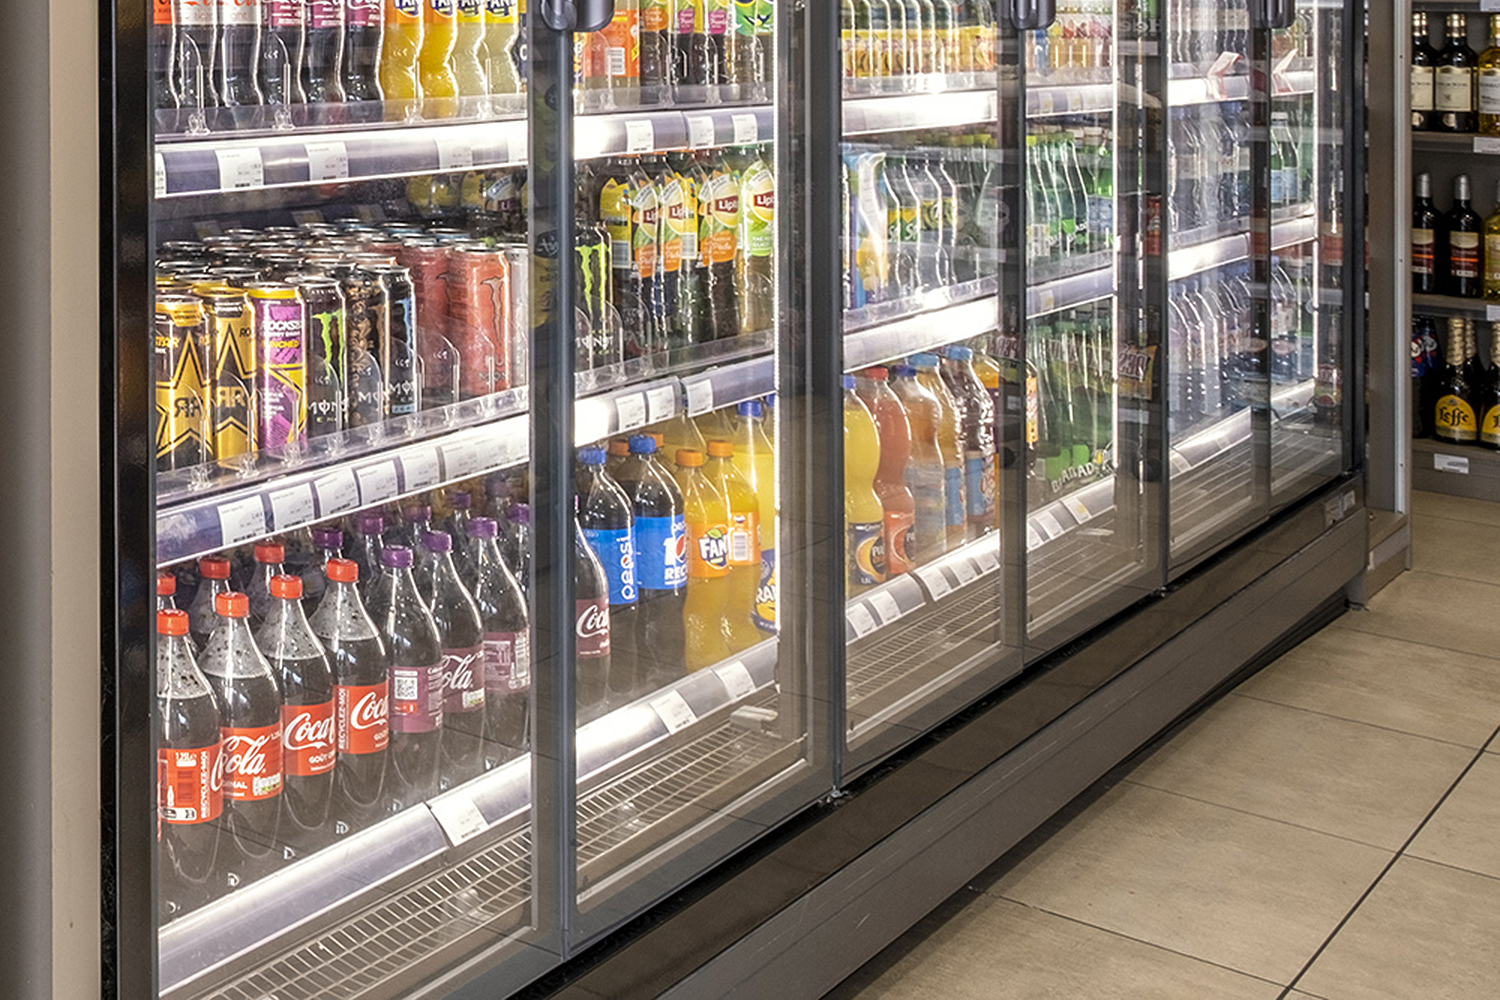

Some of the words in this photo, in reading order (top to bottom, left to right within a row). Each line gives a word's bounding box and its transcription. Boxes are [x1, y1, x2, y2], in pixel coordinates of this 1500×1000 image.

[1438, 406, 1470, 427] Leffe
[617, 535, 635, 600] pepsi
[338, 687, 346, 750] RECYCLEZ-MOI
[200, 750, 209, 819] RECYCLEZ-MOI
